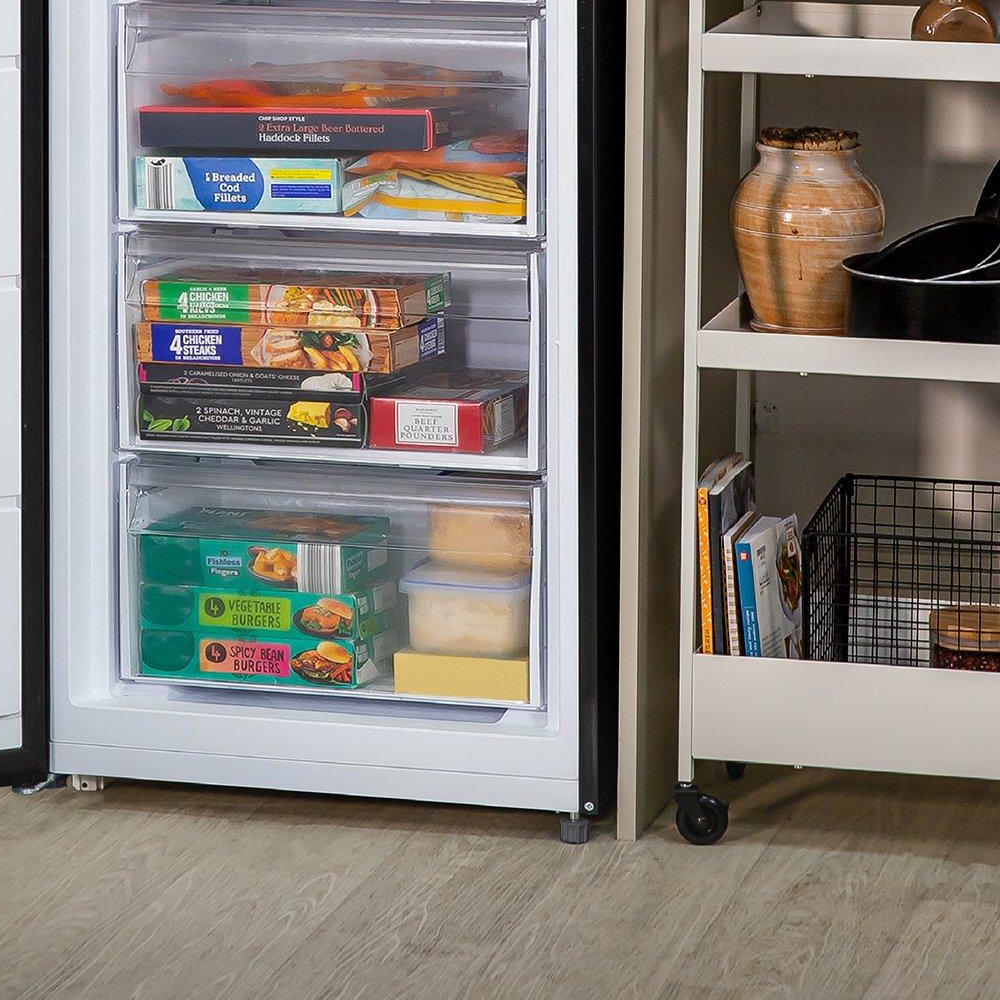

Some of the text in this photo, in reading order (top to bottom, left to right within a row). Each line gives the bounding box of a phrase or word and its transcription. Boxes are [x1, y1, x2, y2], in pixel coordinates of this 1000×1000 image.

[266, 123, 291, 132] Extra
[293, 124, 320, 135] Large
[321, 124, 344, 133] Beer
[345, 124, 385, 133] Battered
[258, 133, 331, 143] Haddock Fillets
[212, 172, 255, 182] Breaded
[219, 183, 240, 192] Cod
[214, 193, 247, 203] Fillets
[189, 292, 229, 302] CHICKEN
[177, 292, 188, 314] 4
[169, 334, 182, 356] 4
[183, 335, 222, 345] CHICKEN
[183, 345, 217, 355] STEAKS
[203, 408, 243, 417] SPINACH,
[244, 409, 282, 417] VINTAGE
[198, 415, 281, 425] CHEDDAR & GARLIC
[216, 424, 263, 432] WELLINGTONS
[403, 424, 449, 433] QUARTER
[400, 432, 453, 441] POUNDERS
[207, 558, 241, 566] Fishless
[210, 568, 239, 576] Fingers
[228, 600, 282, 615] VEGETABLE
[232, 613, 282, 628] BURGERS
[229, 645, 257, 659] SPICY
[260, 648, 284, 662] BEAN
[233, 659, 281, 674] BURGERS
